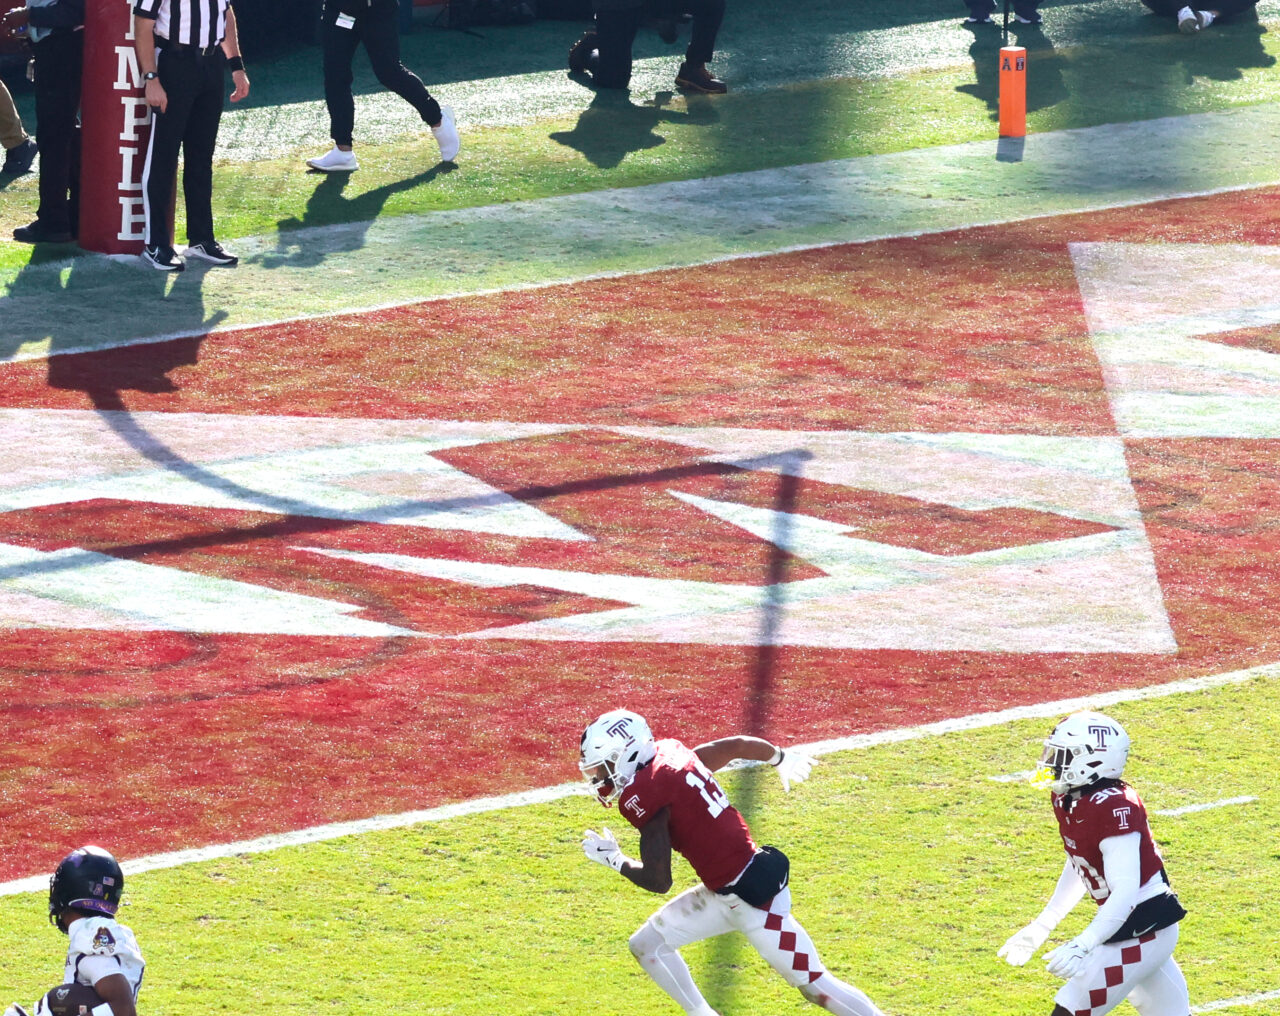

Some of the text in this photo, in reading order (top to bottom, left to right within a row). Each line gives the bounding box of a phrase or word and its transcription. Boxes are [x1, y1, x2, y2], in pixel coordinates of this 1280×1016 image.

[1088, 726, 1111, 751] T
[624, 795, 646, 817] T
[1089, 787, 1123, 805] 30
[1112, 807, 1130, 829] T
